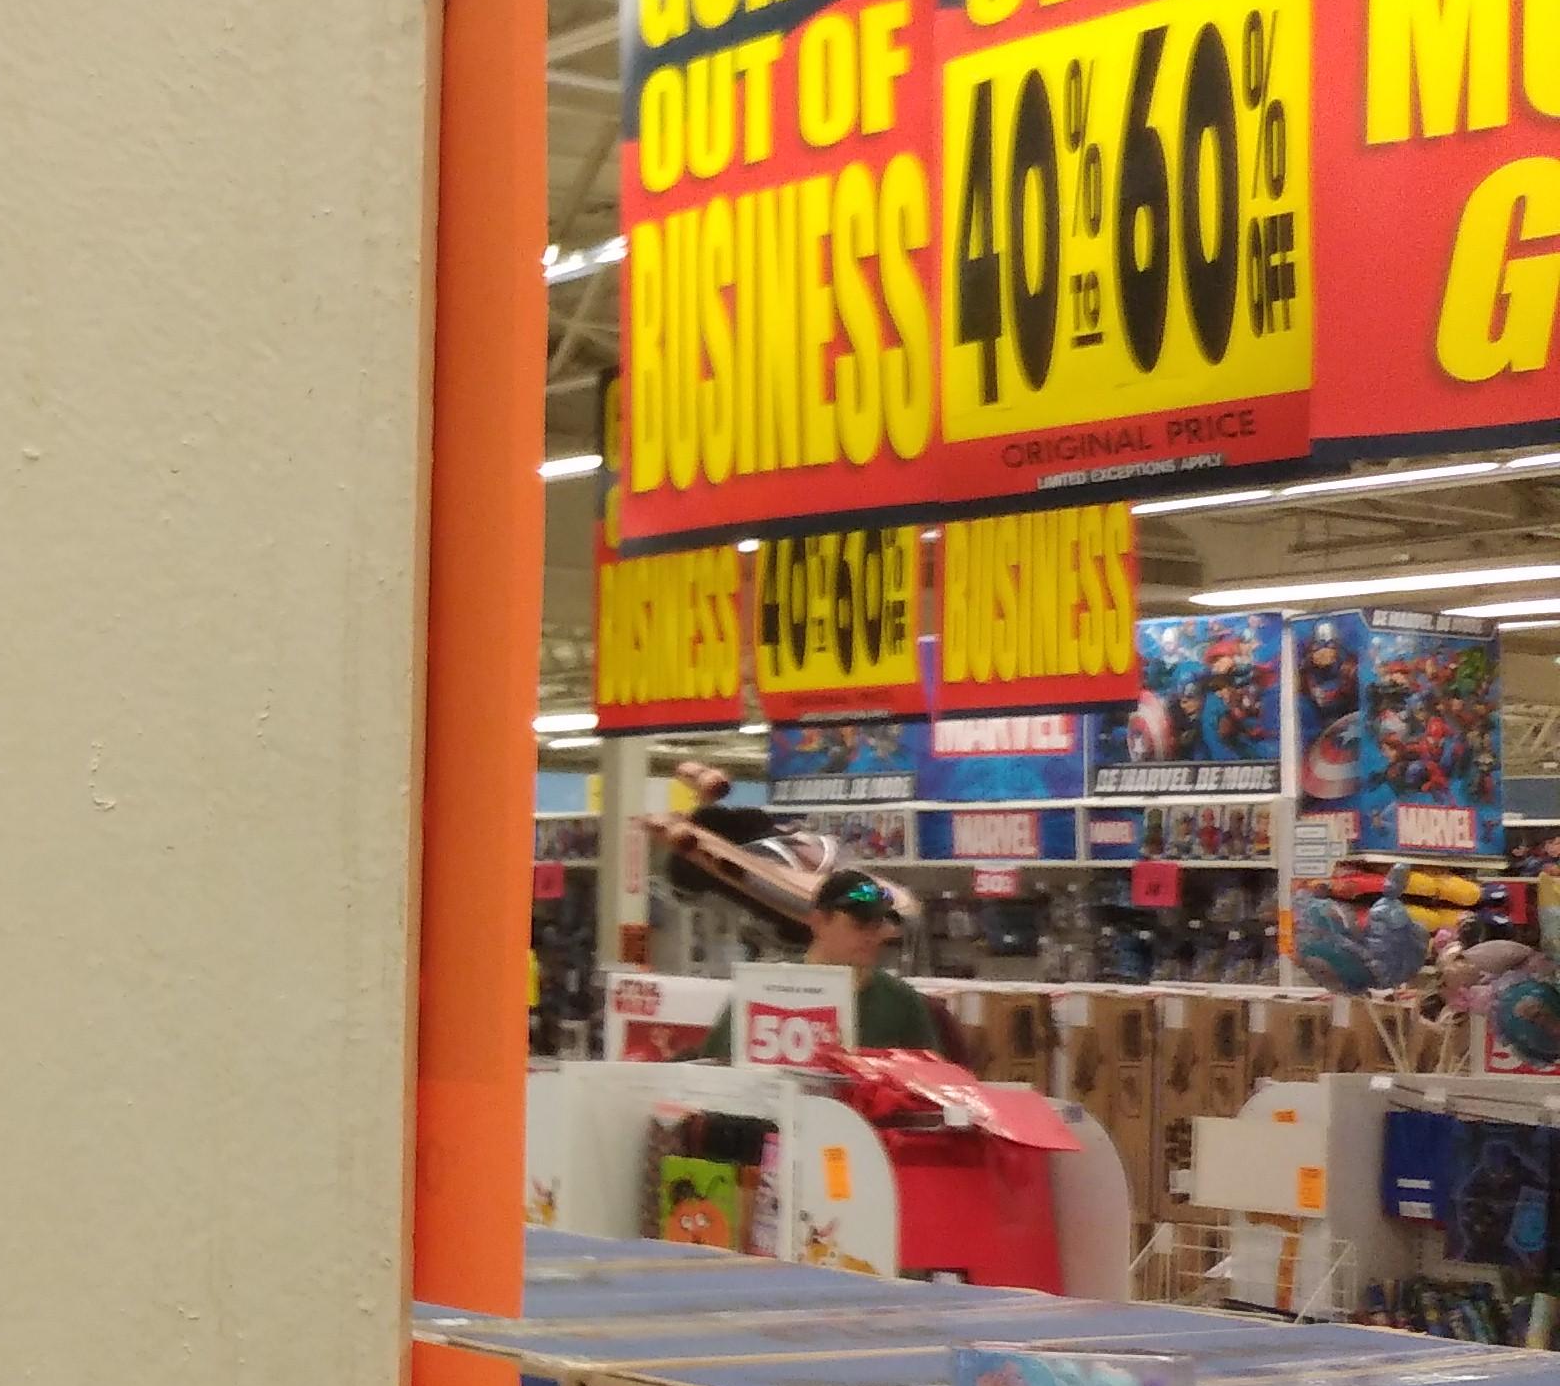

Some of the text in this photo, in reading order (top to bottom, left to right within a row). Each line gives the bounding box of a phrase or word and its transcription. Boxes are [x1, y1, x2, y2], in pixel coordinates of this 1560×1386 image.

[639, 31, 783, 194] OUT
[1244, 211, 1297, 339] OFF
[629, 151, 933, 495] BUSINESS
[1001, 408, 1257, 469] ORIGINAL PRICE
[1036, 452, 1224, 491] LIMITED EXCEPTIONS APPLY
[942, 500, 1134, 685] BUSINESS
[934, 714, 1072, 752] MARVEL
[952, 812, 1038, 856] MARVEL
